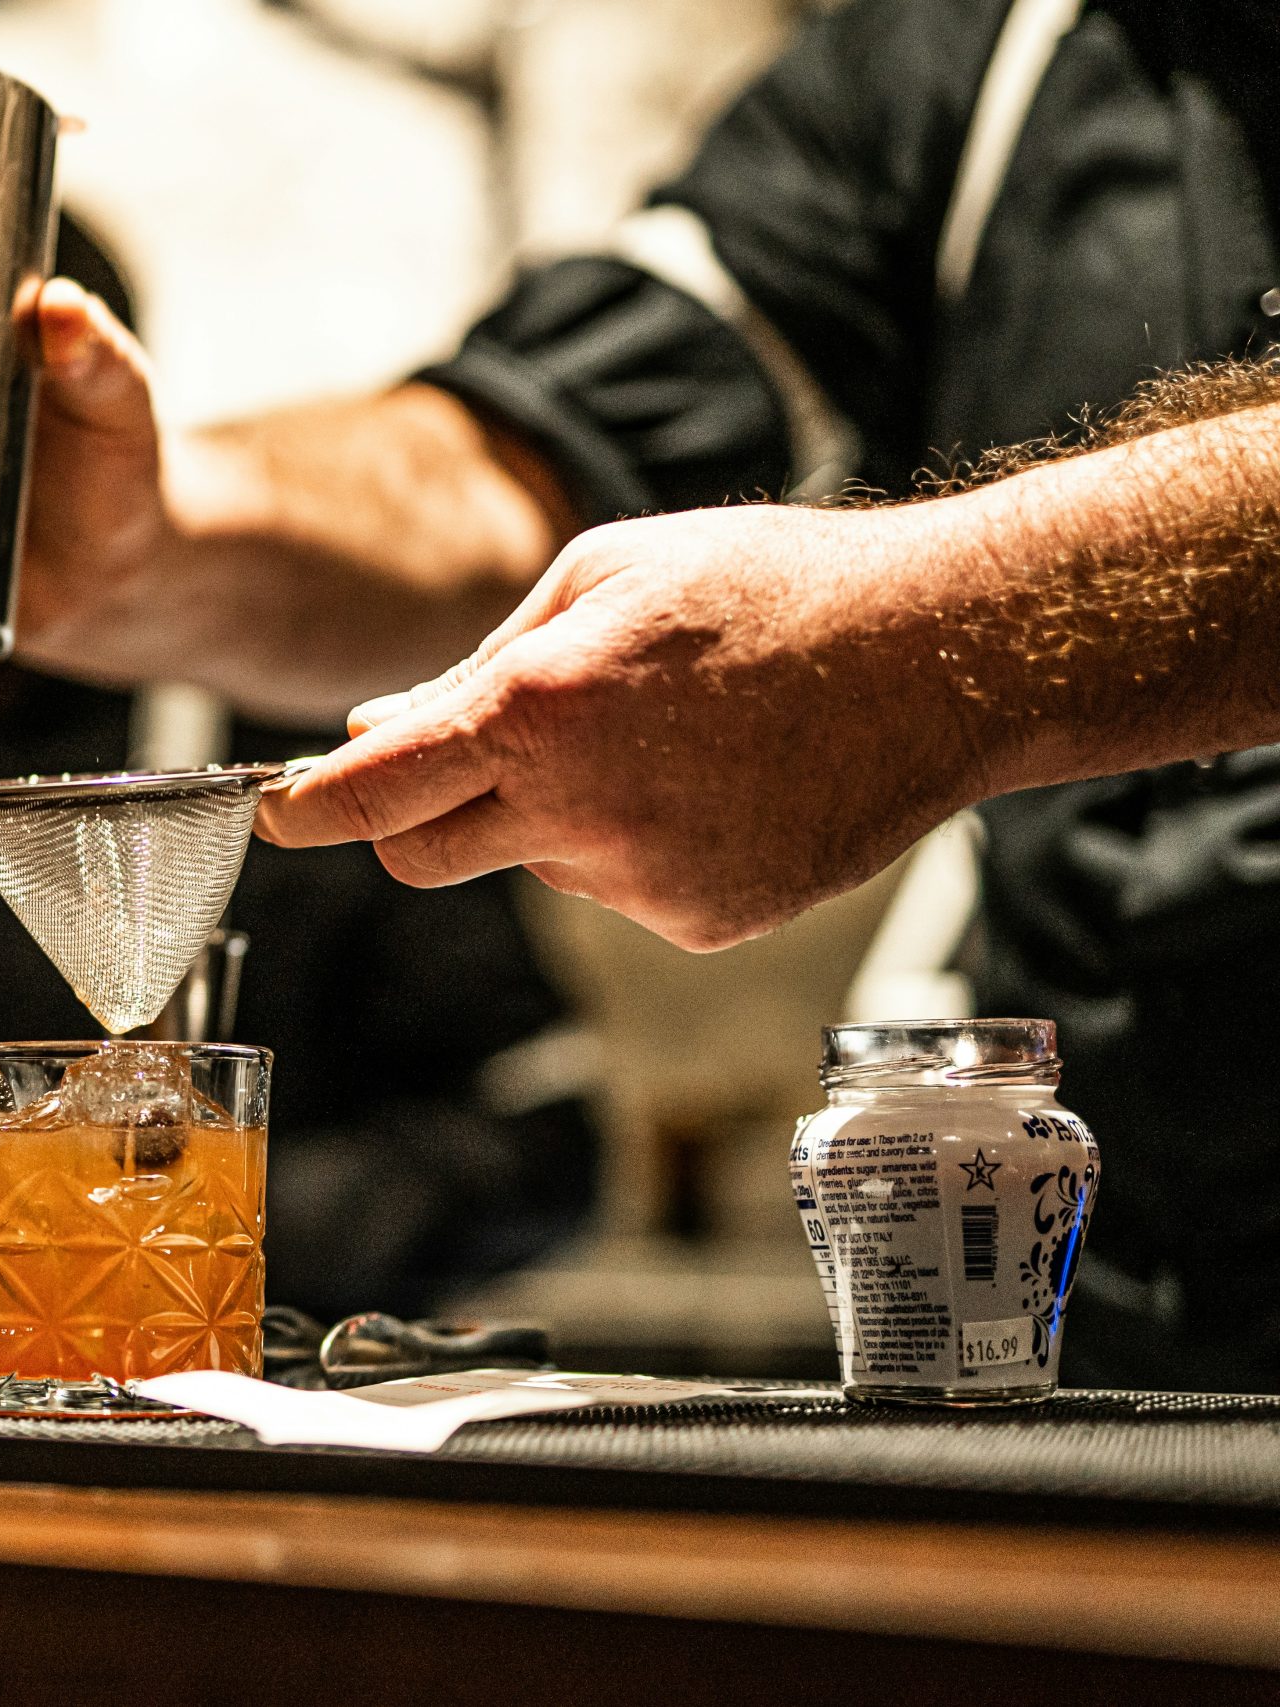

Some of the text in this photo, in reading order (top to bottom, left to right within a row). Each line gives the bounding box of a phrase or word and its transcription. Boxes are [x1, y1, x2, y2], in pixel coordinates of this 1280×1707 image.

[846, 1135, 856, 1147] for
[857, 1136, 871, 1146] use:
[878, 1134, 895, 1148] Tbsp
[897, 1134, 912, 1144] with
[913, 1133, 918, 1143] 2
[919, 1135, 928, 1143] or
[928, 1132, 934, 1142] 3
[836, 1149, 845, 1159] for
[866, 1147, 880, 1157] and
[856, 1163, 880, 1178] sugar,
[881, 1163, 917, 1175] amarena
[920, 1160, 937, 1171] wild
[975, 1167, 987, 1179] K
[909, 1175, 938, 1186] water,
[849, 1188, 864, 1200] wild
[917, 1185, 939, 1197] citric
[869, 1201, 878, 1212] for
[902, 1199, 940, 1211] vegetable
[807, 1219, 825, 1242] 60
[862, 1232, 872, 1243] OF
[873, 1231, 893, 1242] ITALY
[874, 1280, 890, 1290] York
[966, 1336, 1018, 1362] $16.99
